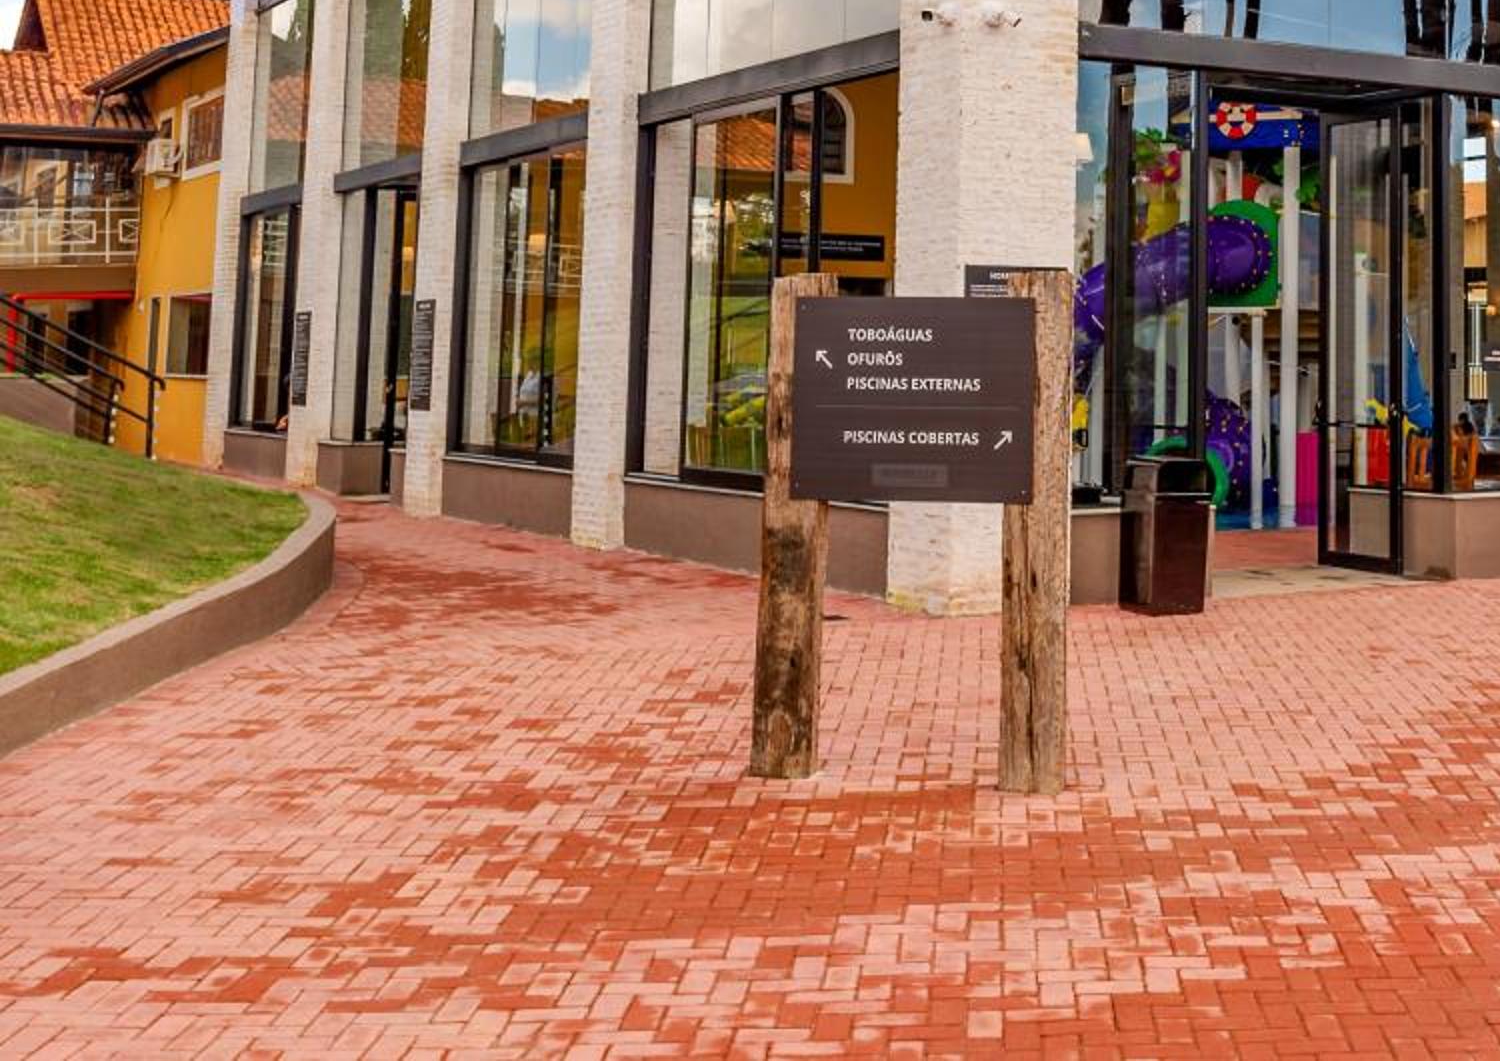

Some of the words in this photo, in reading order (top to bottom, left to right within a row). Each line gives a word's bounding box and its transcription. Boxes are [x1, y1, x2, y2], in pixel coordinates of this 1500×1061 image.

[848, 326, 933, 341] TOBOÁGUAS
[847, 350, 903, 366] OFURÔS
[847, 377, 908, 390] PISCINAS
[911, 378, 981, 392] EXTERNAS
[843, 430, 905, 444] PISCINAS
[908, 432, 980, 446] COBERTAS
